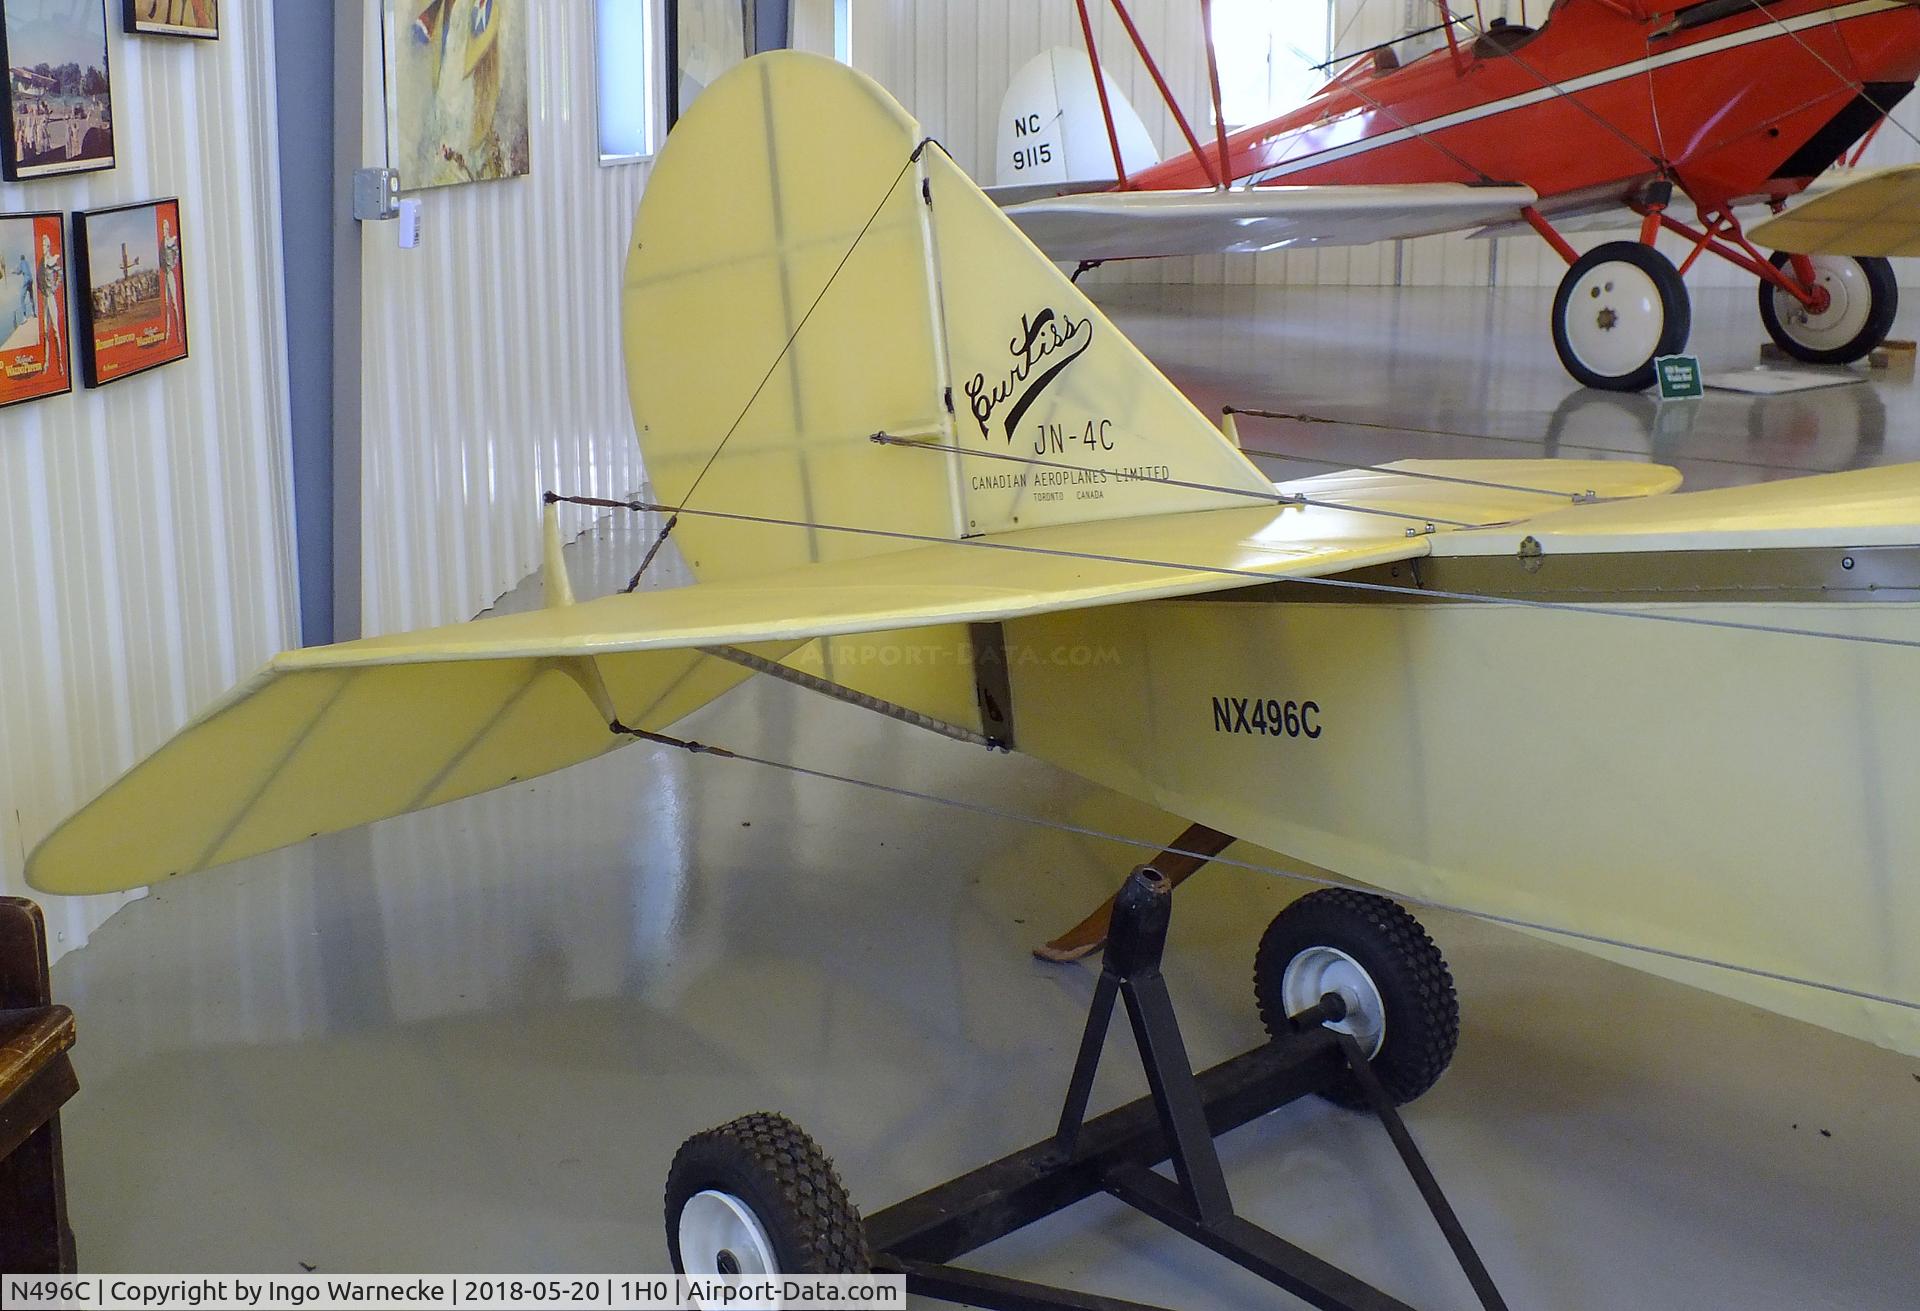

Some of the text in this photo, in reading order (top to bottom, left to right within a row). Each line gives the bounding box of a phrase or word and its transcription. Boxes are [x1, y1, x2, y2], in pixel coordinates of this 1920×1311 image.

[1015, 114, 1041, 137] NC
[1013, 143, 1052, 170] 9115
[964, 307, 1093, 445] Curtiss
[1034, 419, 1114, 455] JN-4C
[971, 465, 1170, 490] CANADIAN AEROPLANES LIMITED
[1033, 490, 1104, 502] TORONTO CANADA
[1212, 696, 1322, 739] NX496C
